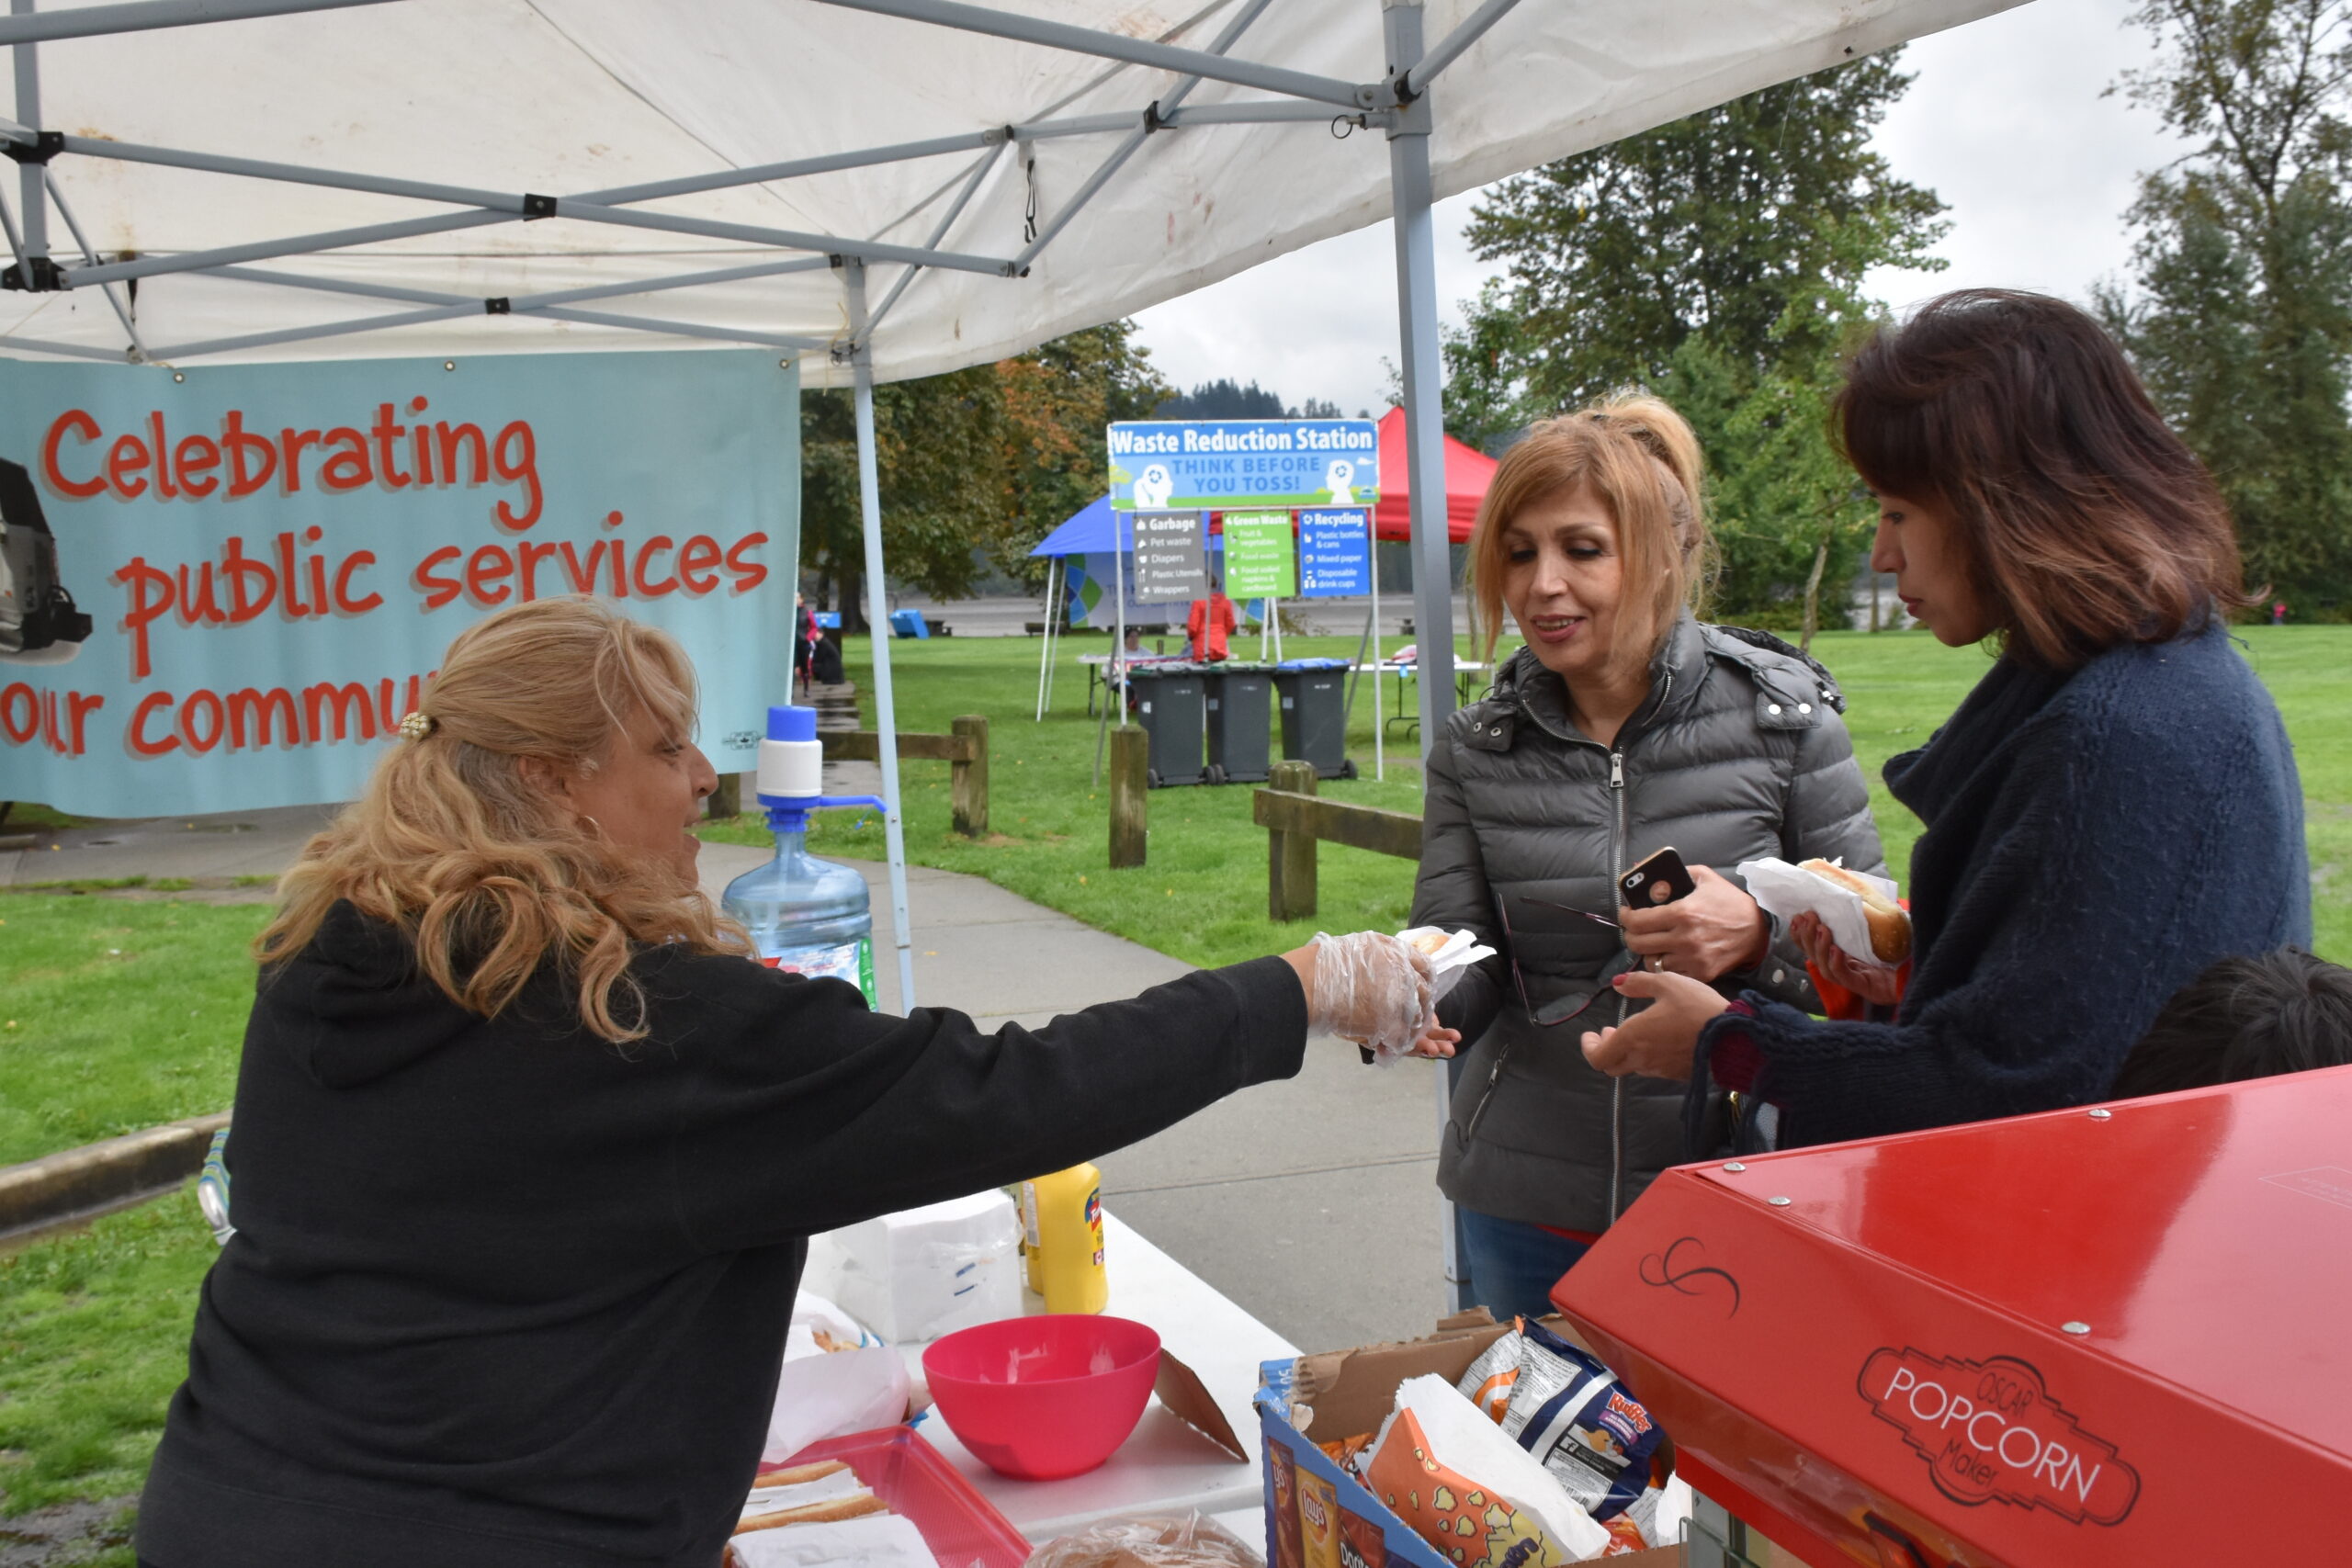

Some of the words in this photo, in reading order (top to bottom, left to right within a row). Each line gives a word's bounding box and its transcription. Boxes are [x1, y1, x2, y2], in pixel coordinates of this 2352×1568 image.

[1113, 430, 1180, 454] Waste
[1183, 427, 1292, 453] Reduction
[1296, 426, 1373, 450] Station
[41, 395, 544, 532] Celebrating
[1171, 459, 1237, 475] THINK
[1243, 457, 1321, 473] BEFORE
[1194, 477, 1237, 493] YOU
[1242, 476, 1301, 492] TOSS!
[1149, 517, 1196, 532] Garbage
[1233, 514, 1260, 525] Green
[1261, 513, 1288, 524] Waste
[1315, 512, 1364, 527] Recycling
[1150, 536, 1165, 547] Pet
[1167, 536, 1193, 546] waste
[1317, 531, 1339, 539] Plastic
[1340, 530, 1365, 538] bottles
[1151, 553, 1185, 564] Diapers
[1341, 555, 1363, 563] paper
[1152, 570, 1175, 578] Plastic
[1176, 568, 1204, 577] Utensils
[1318, 567, 1358, 578] Disposable
[1153, 585, 1191, 595] Wrappers
[1318, 579, 1338, 588] drink
[1339, 580, 1356, 589] cups
[114, 525, 383, 678] public
[415, 511, 770, 611] services
[0, 680, 105, 755] our
[128, 671, 439, 759] commu
[1975, 1371, 2034, 1419] OSCAR
[1606, 1392, 1653, 1433] Ruffles
[1883, 1366, 2101, 1504] POPCORN
[1939, 1437, 1999, 1488] Maker
[1272, 1462, 1285, 1488] y's
[1301, 1487, 1326, 1527] Lay's
